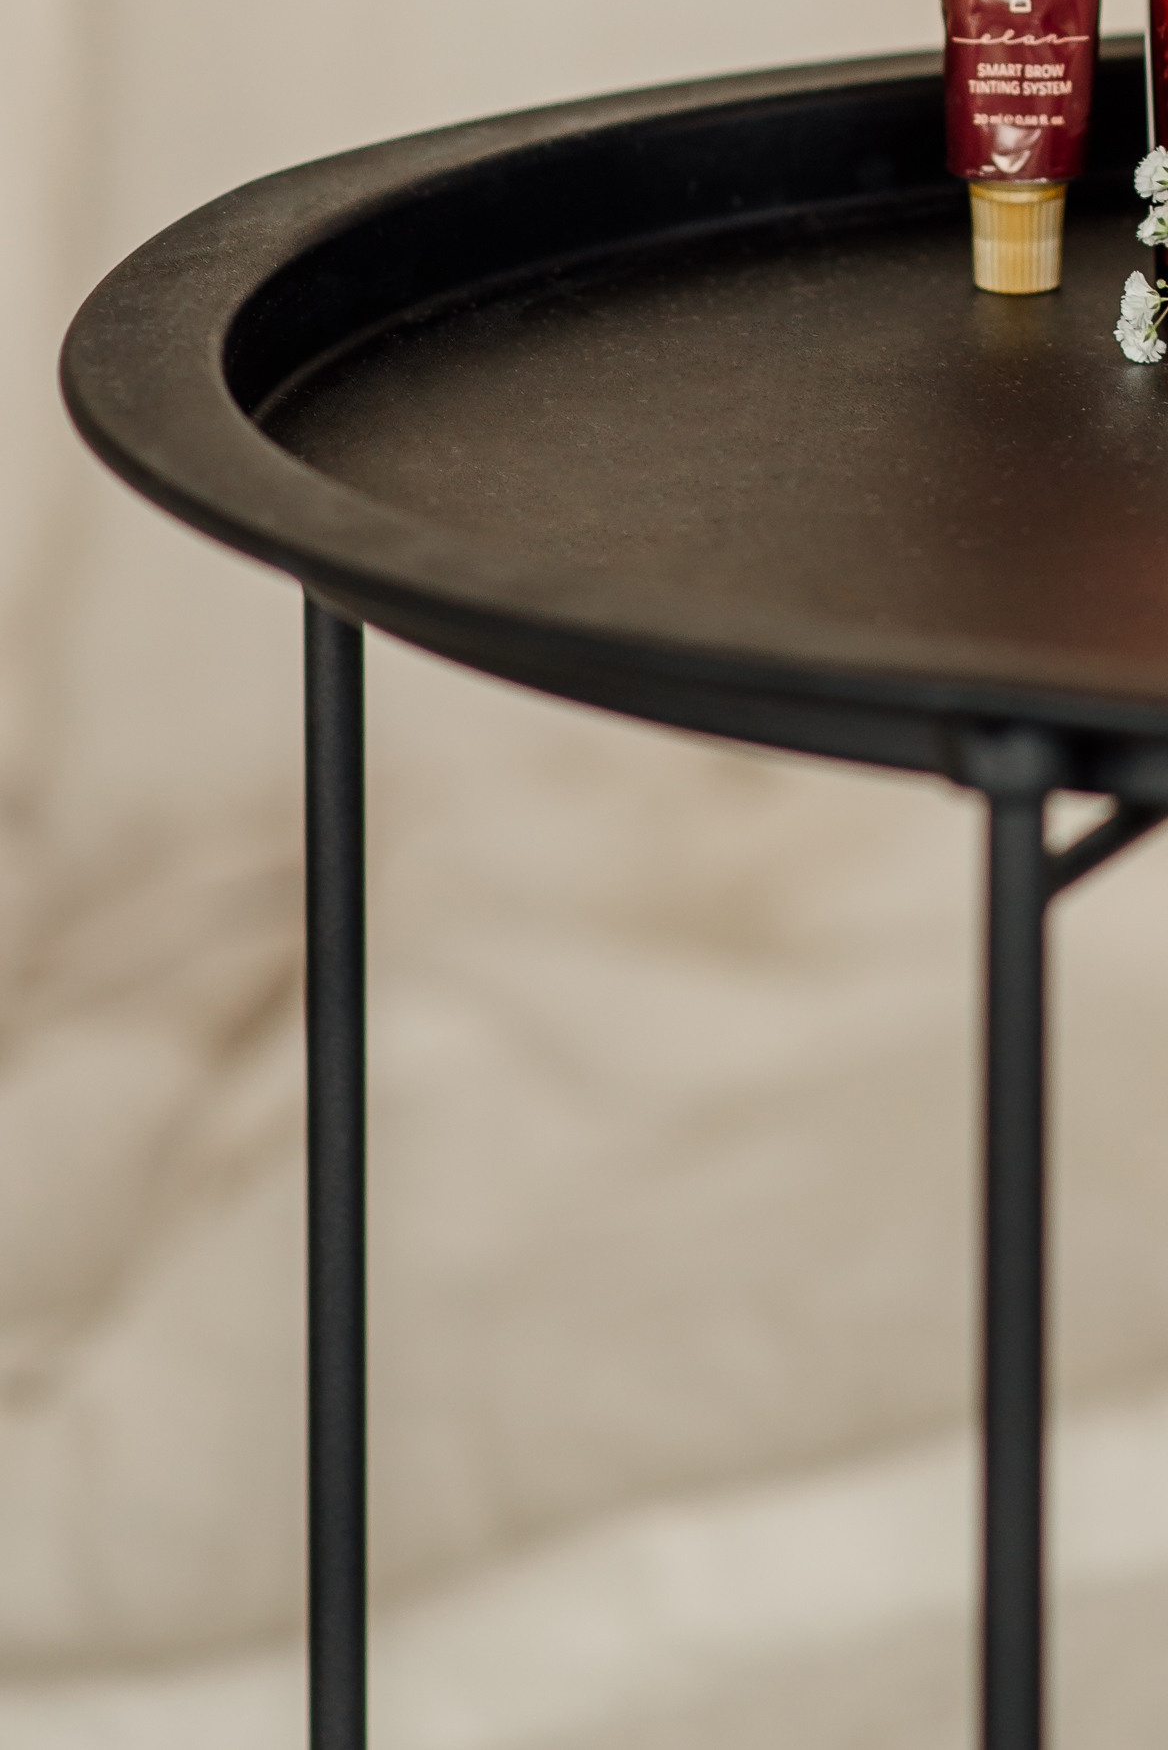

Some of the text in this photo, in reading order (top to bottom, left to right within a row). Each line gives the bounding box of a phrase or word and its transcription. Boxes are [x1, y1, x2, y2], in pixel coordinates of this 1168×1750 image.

[976, 62, 1065, 79] SMART BROW
[968, 79, 1073, 96] TINTING SYSTEM
